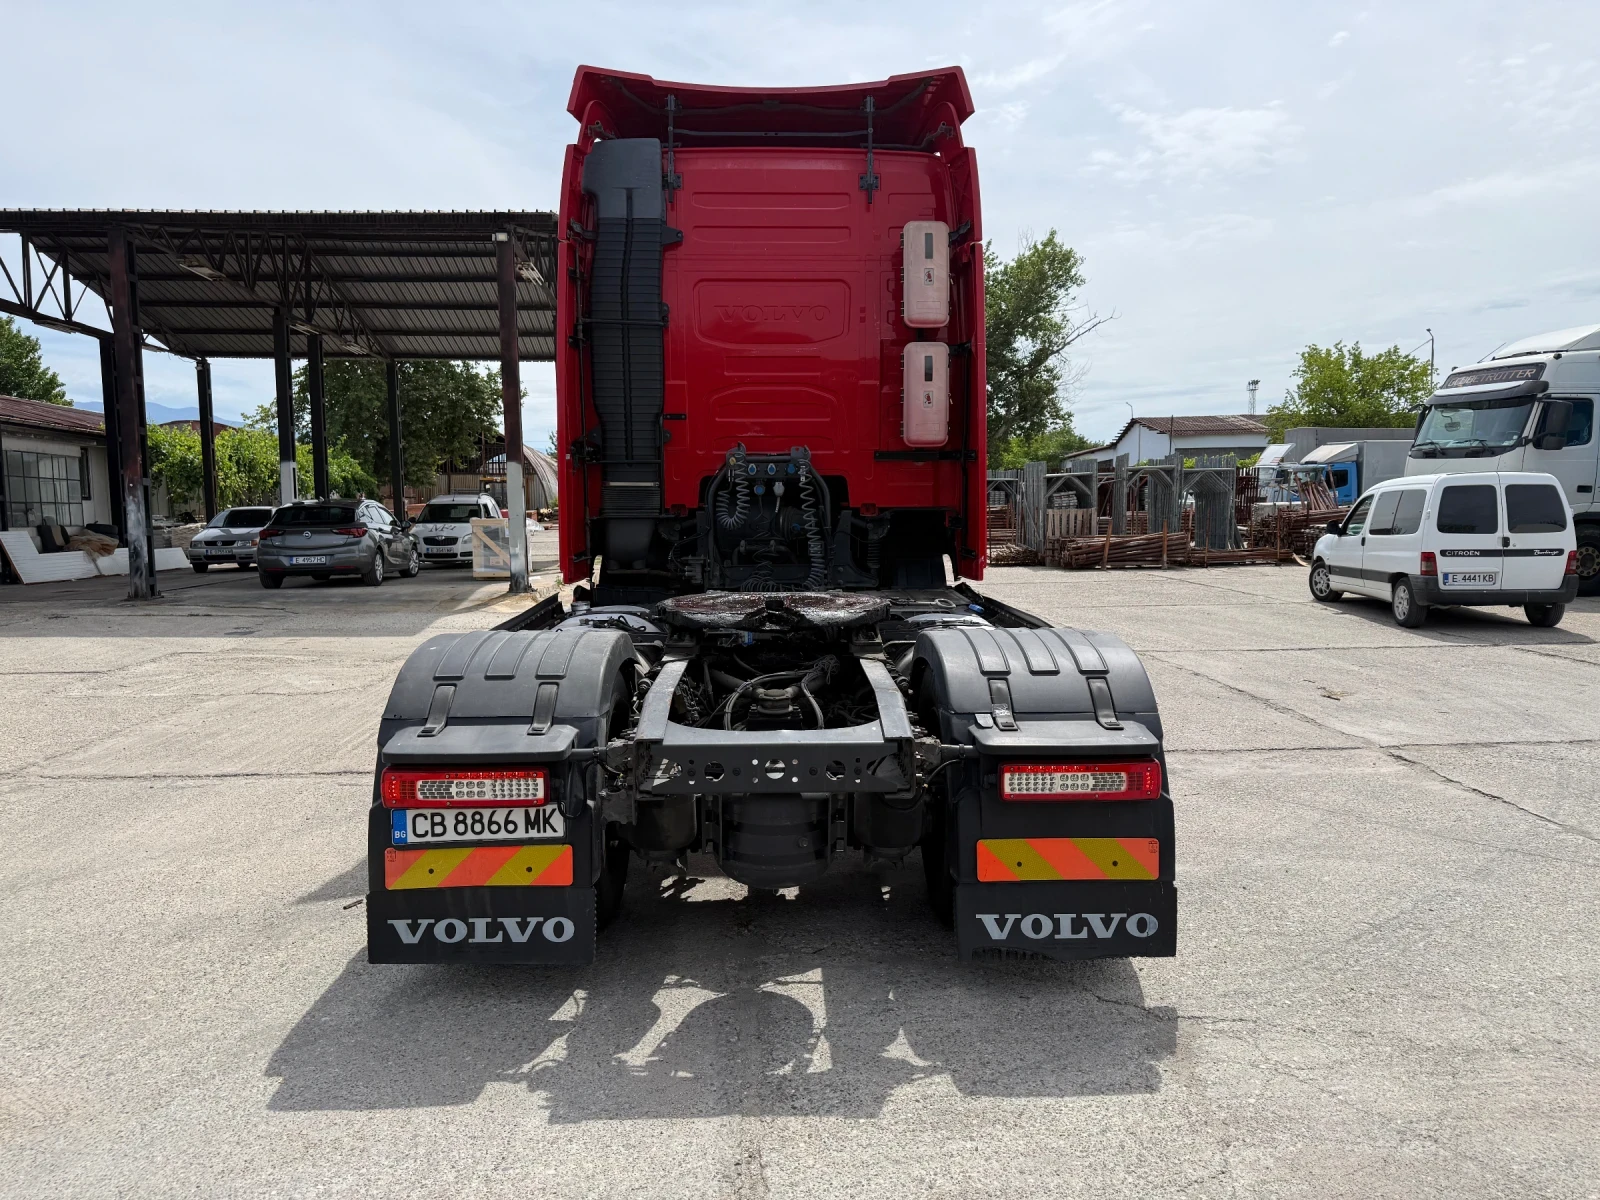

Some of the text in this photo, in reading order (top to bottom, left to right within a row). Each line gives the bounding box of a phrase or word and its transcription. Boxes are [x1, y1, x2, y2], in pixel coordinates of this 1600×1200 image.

[713, 304, 831, 322] VOLVO
[1461, 574, 1481, 583] 4441
[411, 807, 559, 838] CB 8866 MK
[394, 830, 407, 839] BG
[387, 916, 575, 944] VOLVO
[975, 912, 1159, 940] VOLVO
